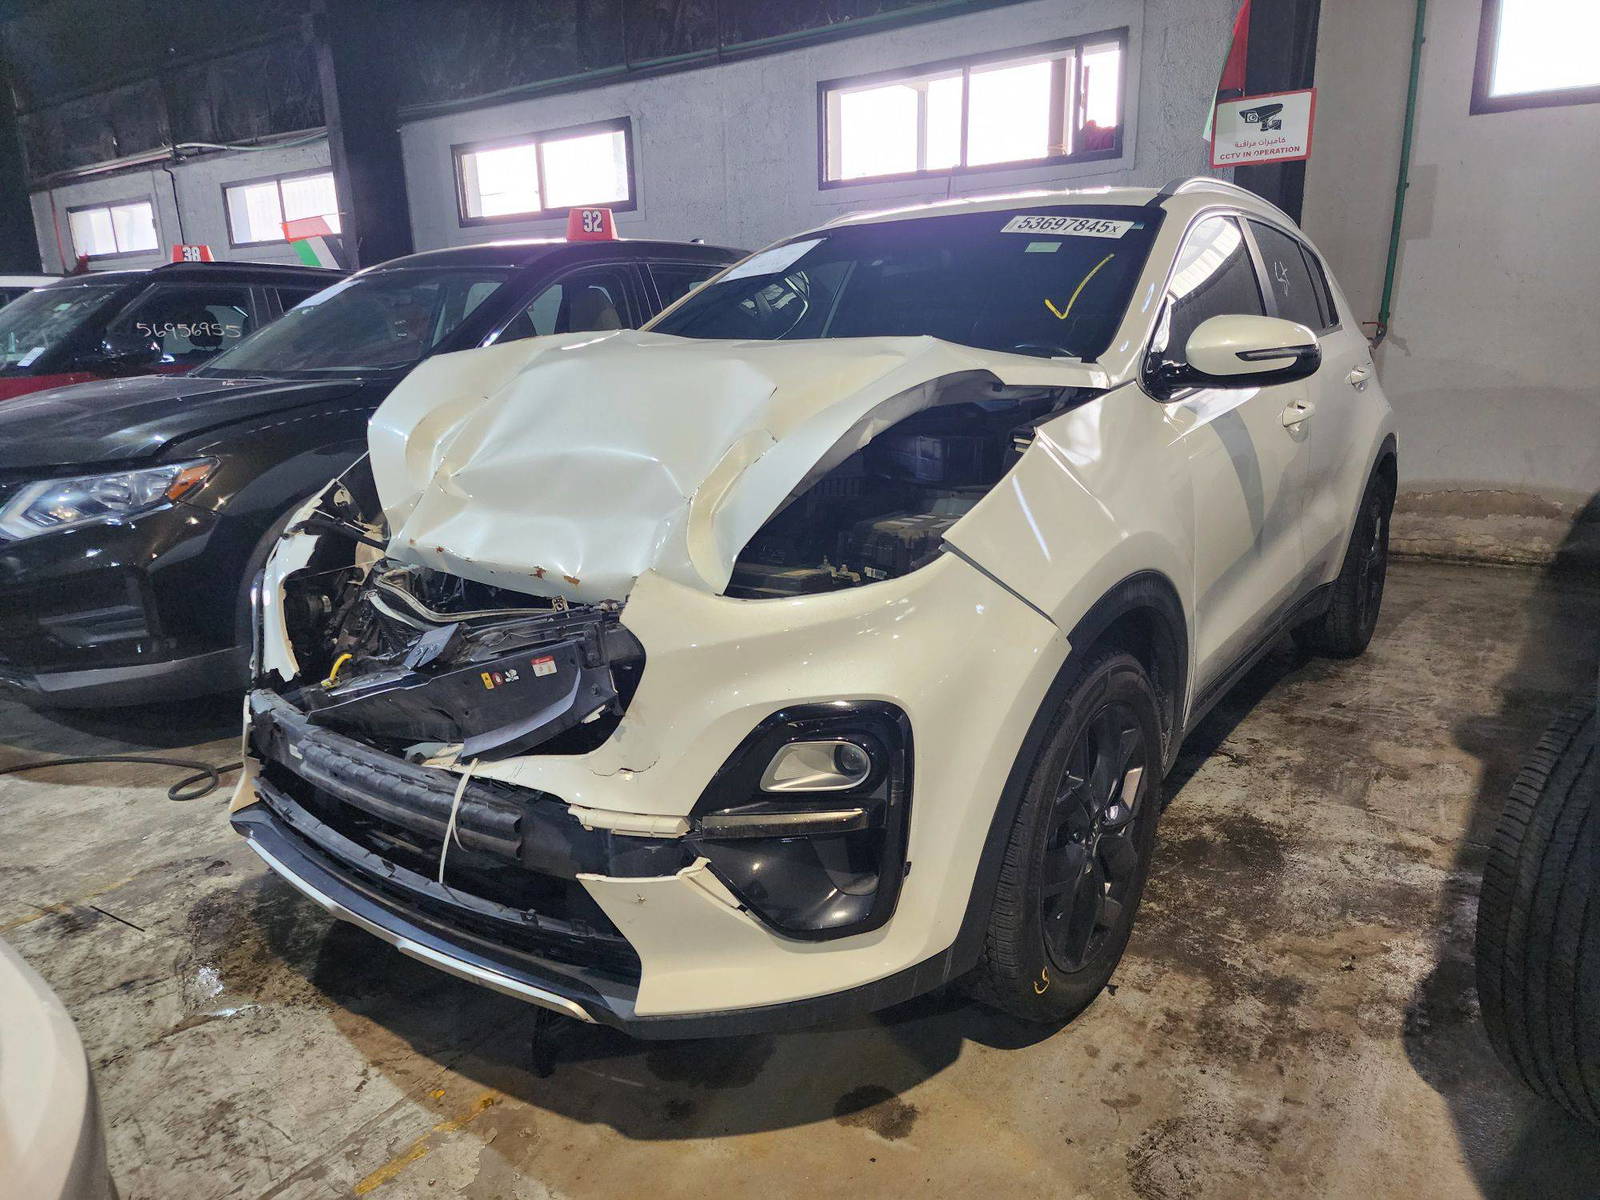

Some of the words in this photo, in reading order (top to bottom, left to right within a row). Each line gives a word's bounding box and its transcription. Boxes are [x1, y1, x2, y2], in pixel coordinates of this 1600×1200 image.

[1220, 151, 1241, 160] CCTV
[1242, 149, 1252, 158] IN
[1253, 145, 1301, 157] OPERATION
[582, 210, 603, 233] 32
